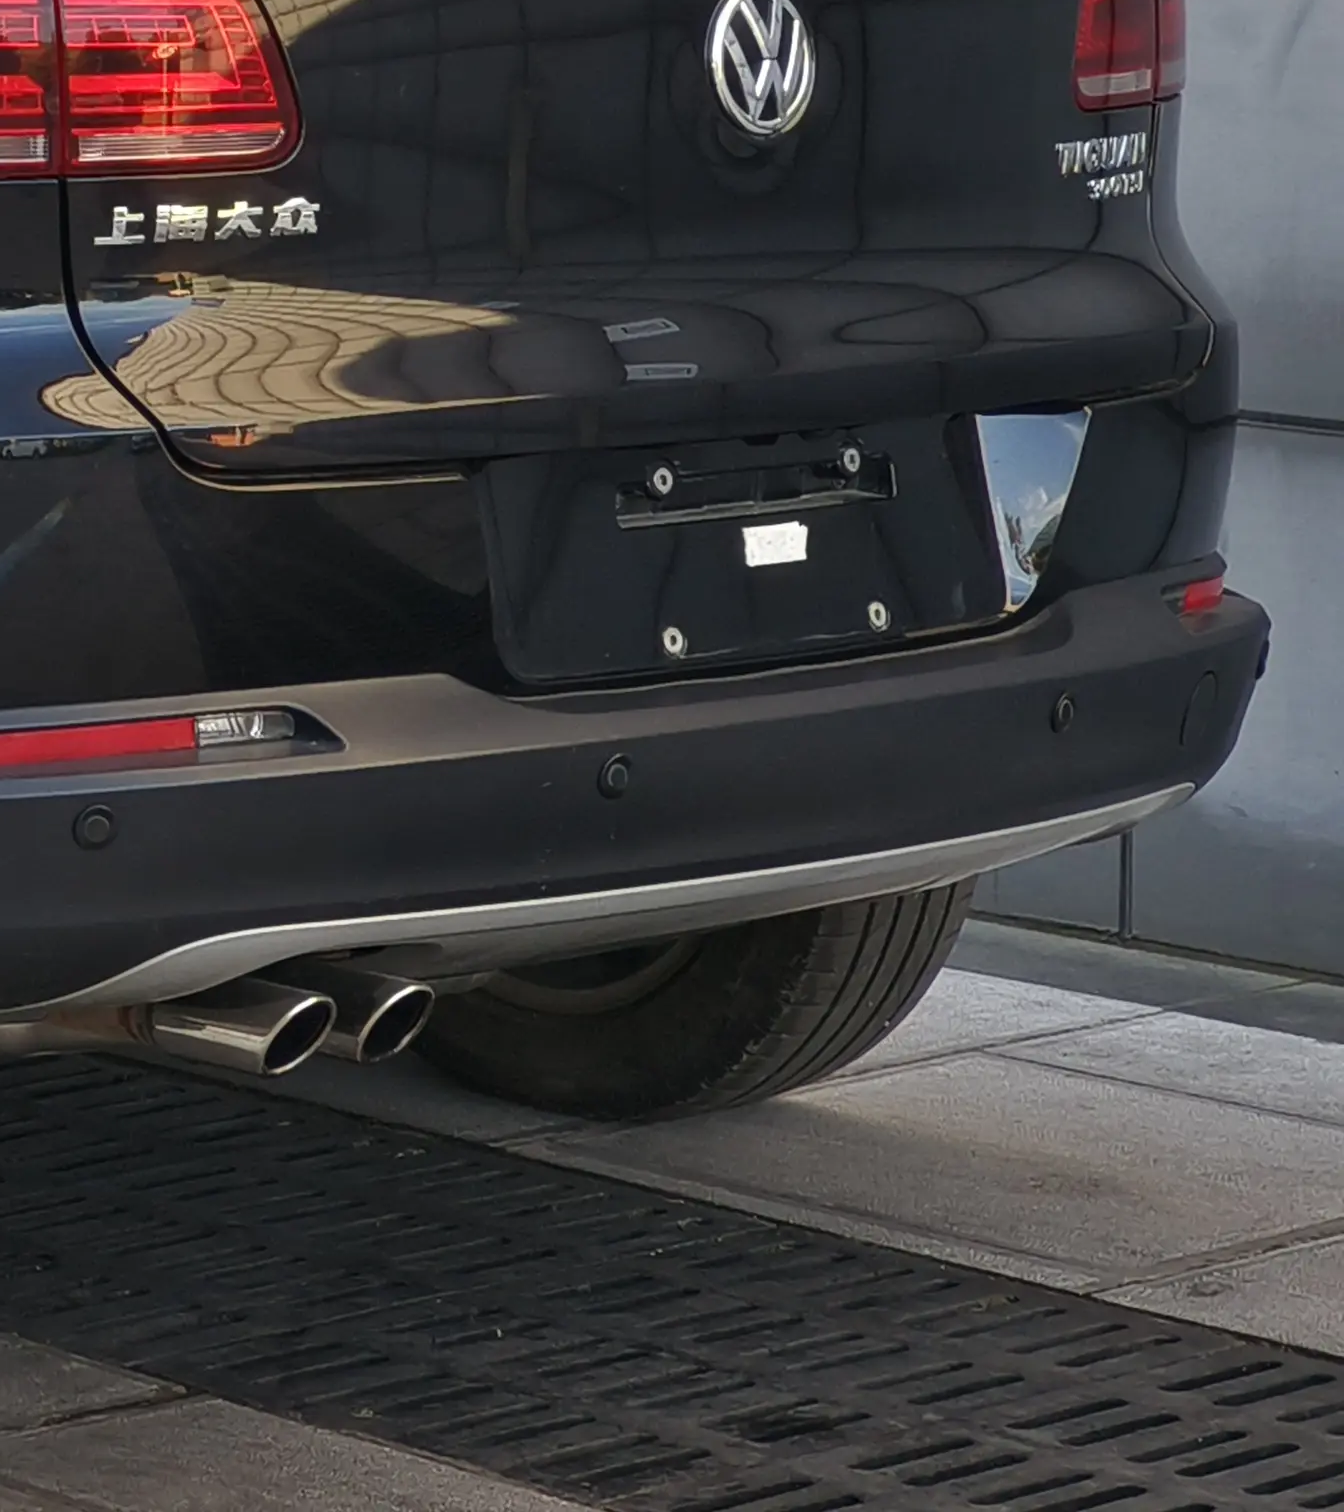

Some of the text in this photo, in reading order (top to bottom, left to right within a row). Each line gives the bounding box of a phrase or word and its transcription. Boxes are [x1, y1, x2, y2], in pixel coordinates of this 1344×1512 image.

[1055, 131, 1147, 176] TIGUAN
[93, 196, 321, 246] 上海大众
